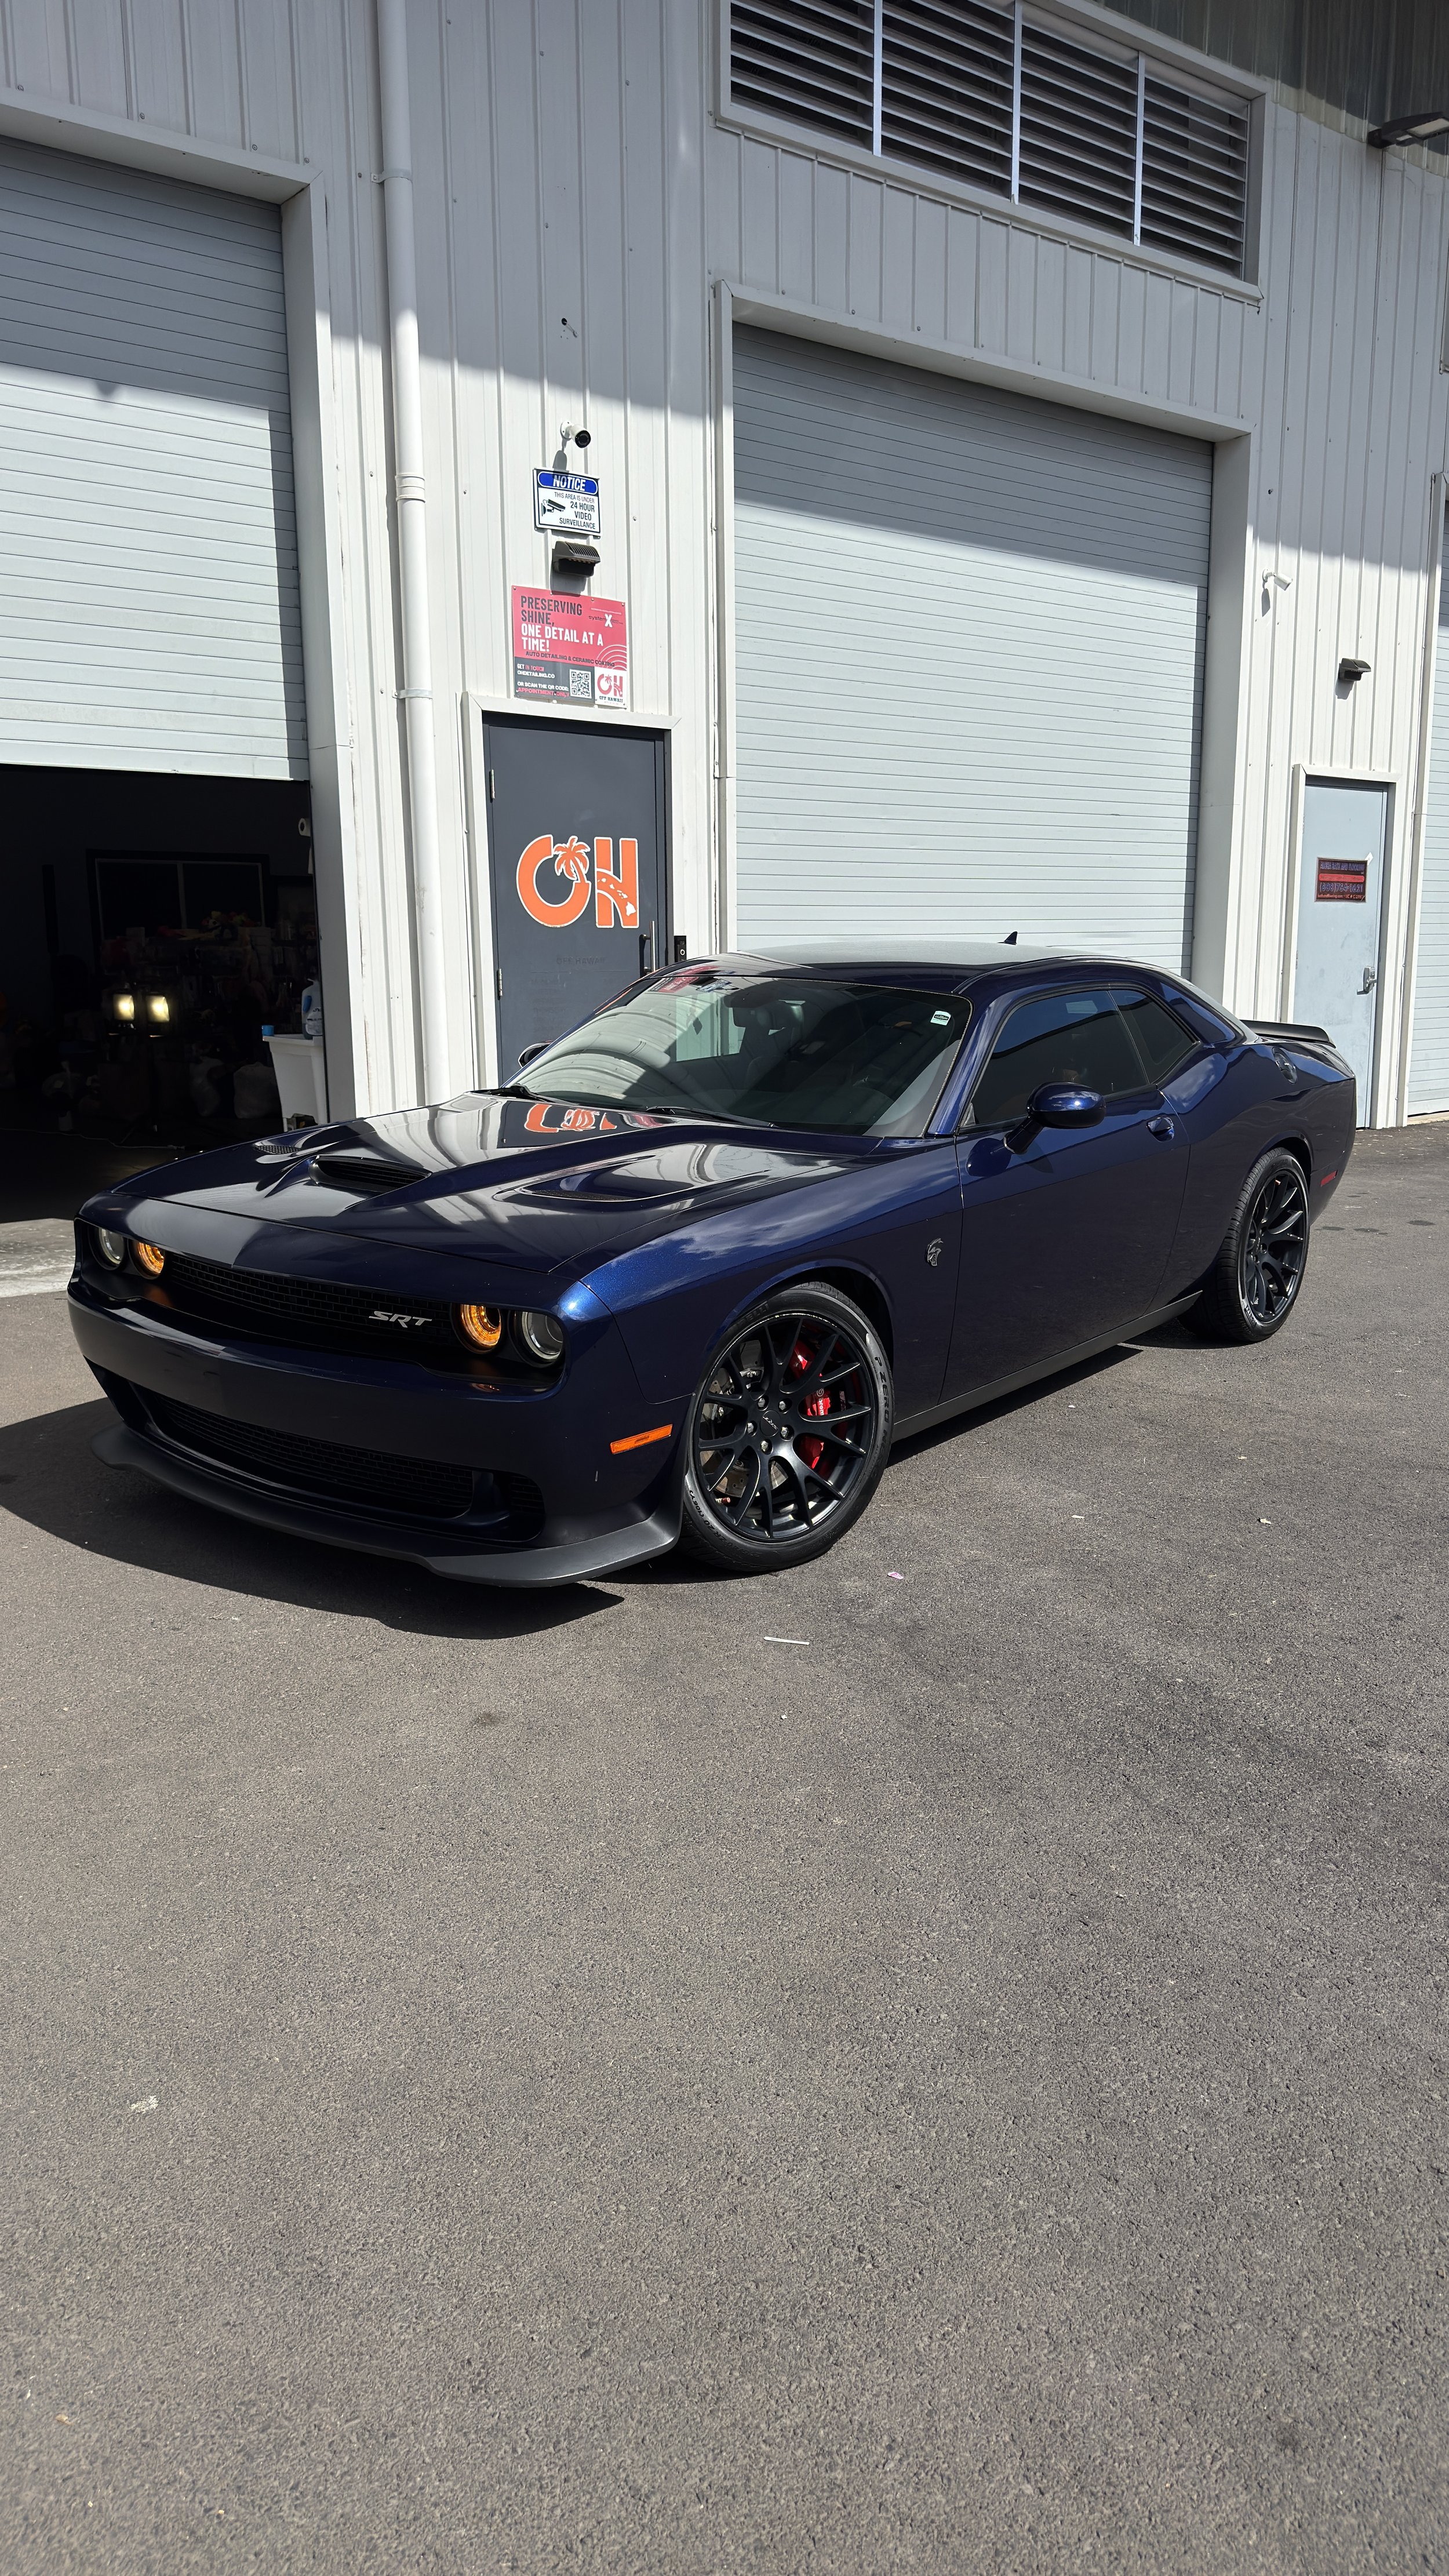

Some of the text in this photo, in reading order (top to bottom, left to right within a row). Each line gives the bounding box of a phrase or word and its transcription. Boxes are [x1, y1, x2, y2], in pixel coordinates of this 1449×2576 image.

[553, 475, 586, 491] NOTICE
[570, 501, 595, 512] 24 HOUR
[581, 496, 595, 504] UNDER
[559, 518, 595, 529] SURVEILLANCE
[574, 511, 592, 521] VIDEO
[520, 595, 582, 616] PRESERVING
[521, 610, 555, 627] SHINE,
[521, 624, 603, 646] ONE DETAIL AT A
[521, 637, 549, 652] TIME!
[518, 687, 554, 696] APPOINTMENT
[369, 1311, 432, 1328] SRT
[874, 1356, 882, 1366] P
[879, 1371, 889, 1422] ZERO
[704, 1520, 715, 1530] 20
